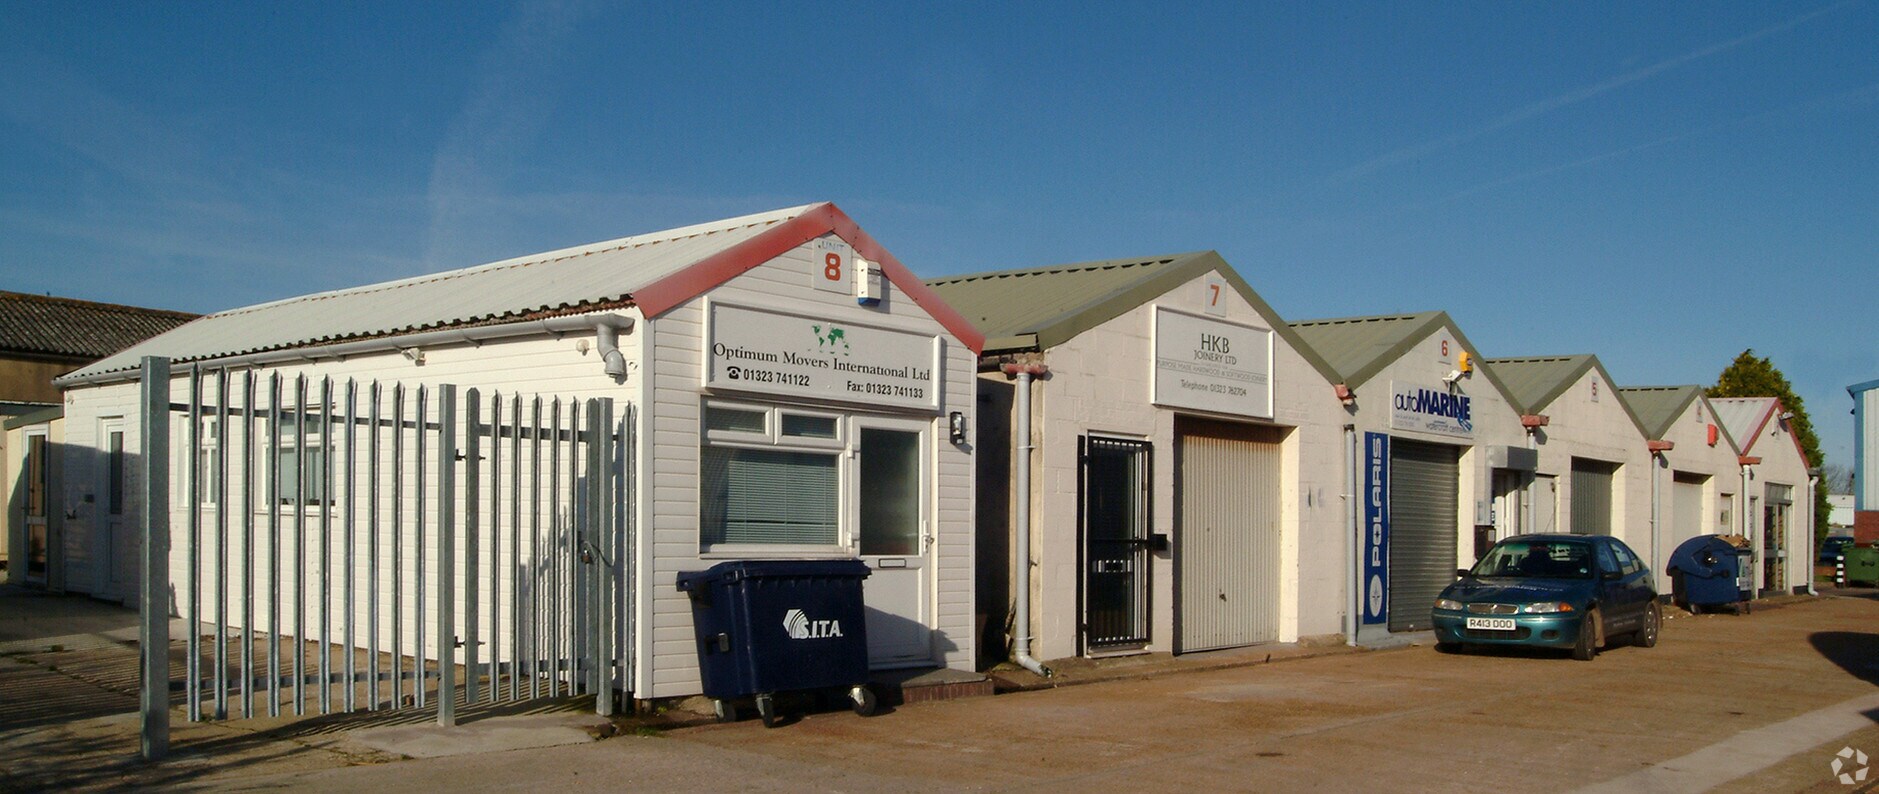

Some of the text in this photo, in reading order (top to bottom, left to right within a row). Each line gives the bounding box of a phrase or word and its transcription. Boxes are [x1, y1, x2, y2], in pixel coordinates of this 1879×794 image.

[821, 239, 845, 251] UNIT
[824, 252, 841, 282] 8
[1210, 284, 1220, 306] 7
[1201, 333, 1230, 354] HKB
[1441, 340, 1448, 357] 6
[713, 342, 931, 381] Optimum Movers International Ltd
[1194, 350, 1237, 365] JOINERY LTD
[743, 368, 810, 387] 01323 741122
[1181, 379, 1208, 391] Telephone
[847, 381, 923, 399] Fax: 01323 741133
[1592, 382, 1597, 396] 5
[1395, 388, 1471, 421] autoMARINE
[1372, 437, 1382, 567] POLARIS
[1469, 619, 1491, 627] R413
